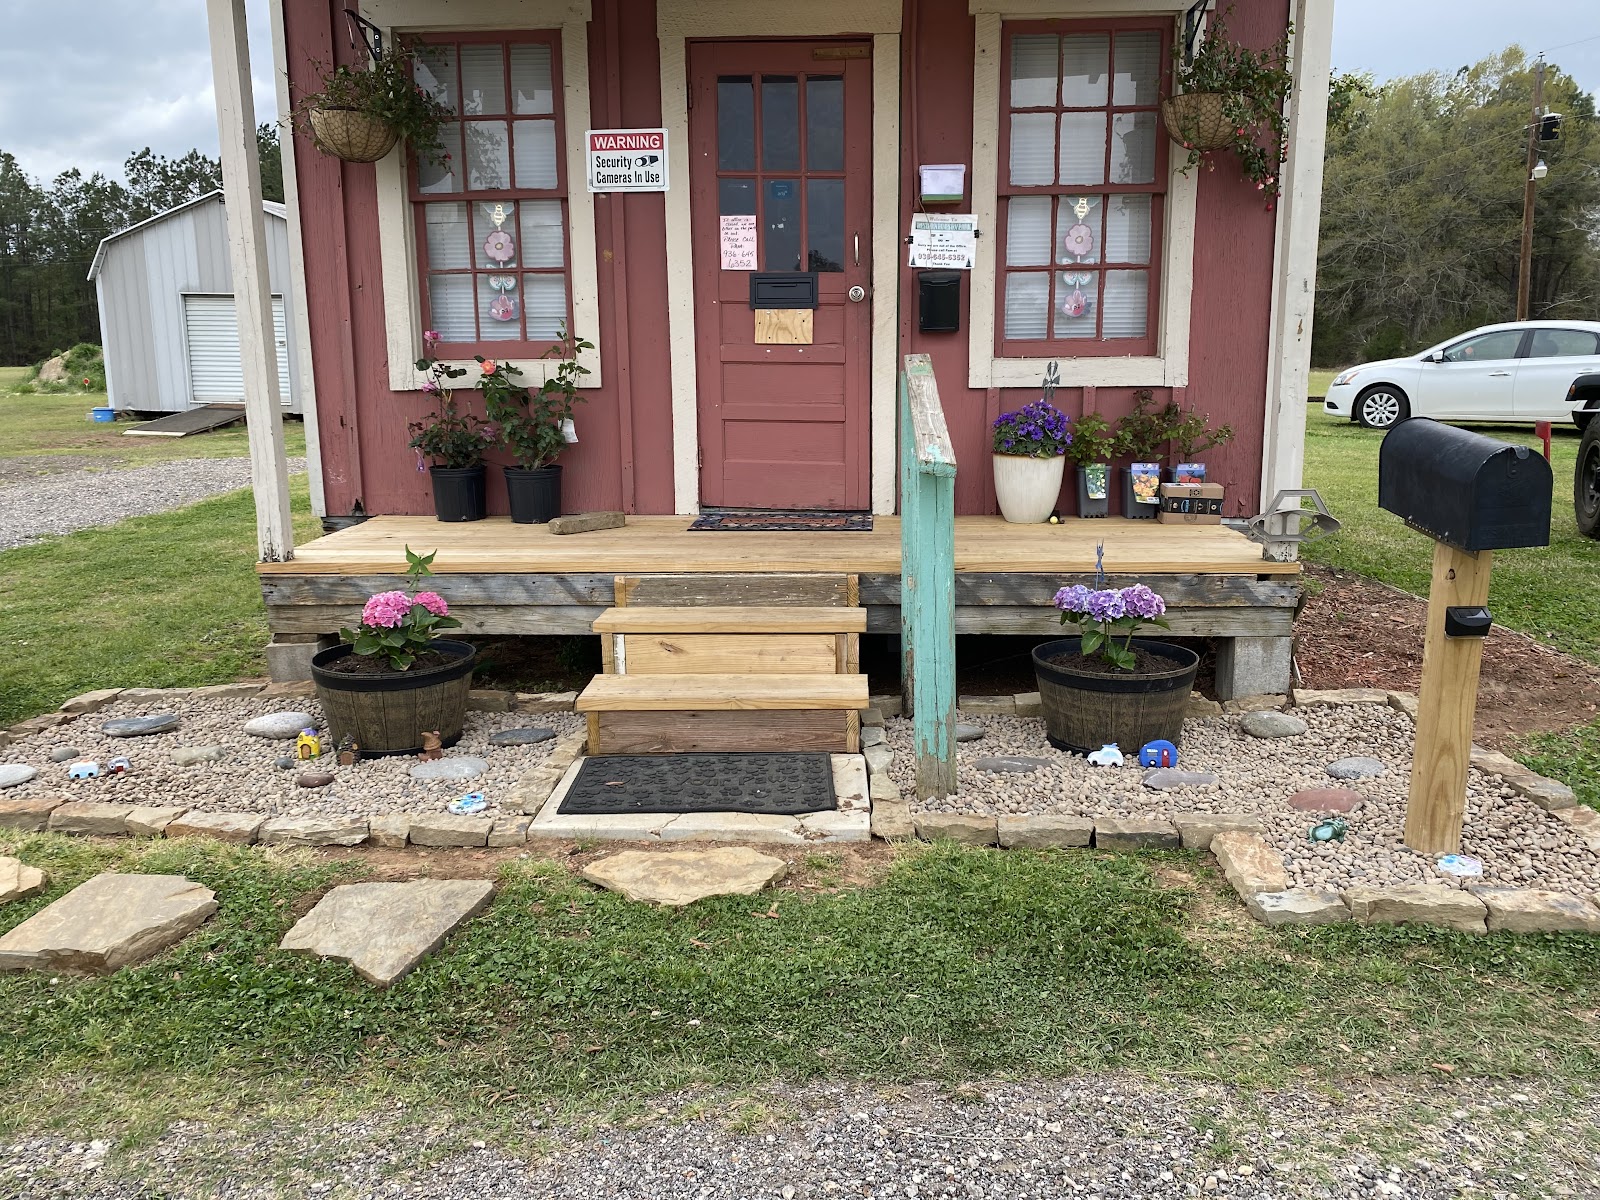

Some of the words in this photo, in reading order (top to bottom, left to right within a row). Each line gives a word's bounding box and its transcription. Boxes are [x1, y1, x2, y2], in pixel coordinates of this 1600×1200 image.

[594, 135, 660, 149] WARNING
[596, 155, 632, 170] Security
[596, 171, 632, 184] Cameras
[634, 171, 643, 183] In
[645, 171, 660, 183] Use
[728, 258, 752, 269] 6352
